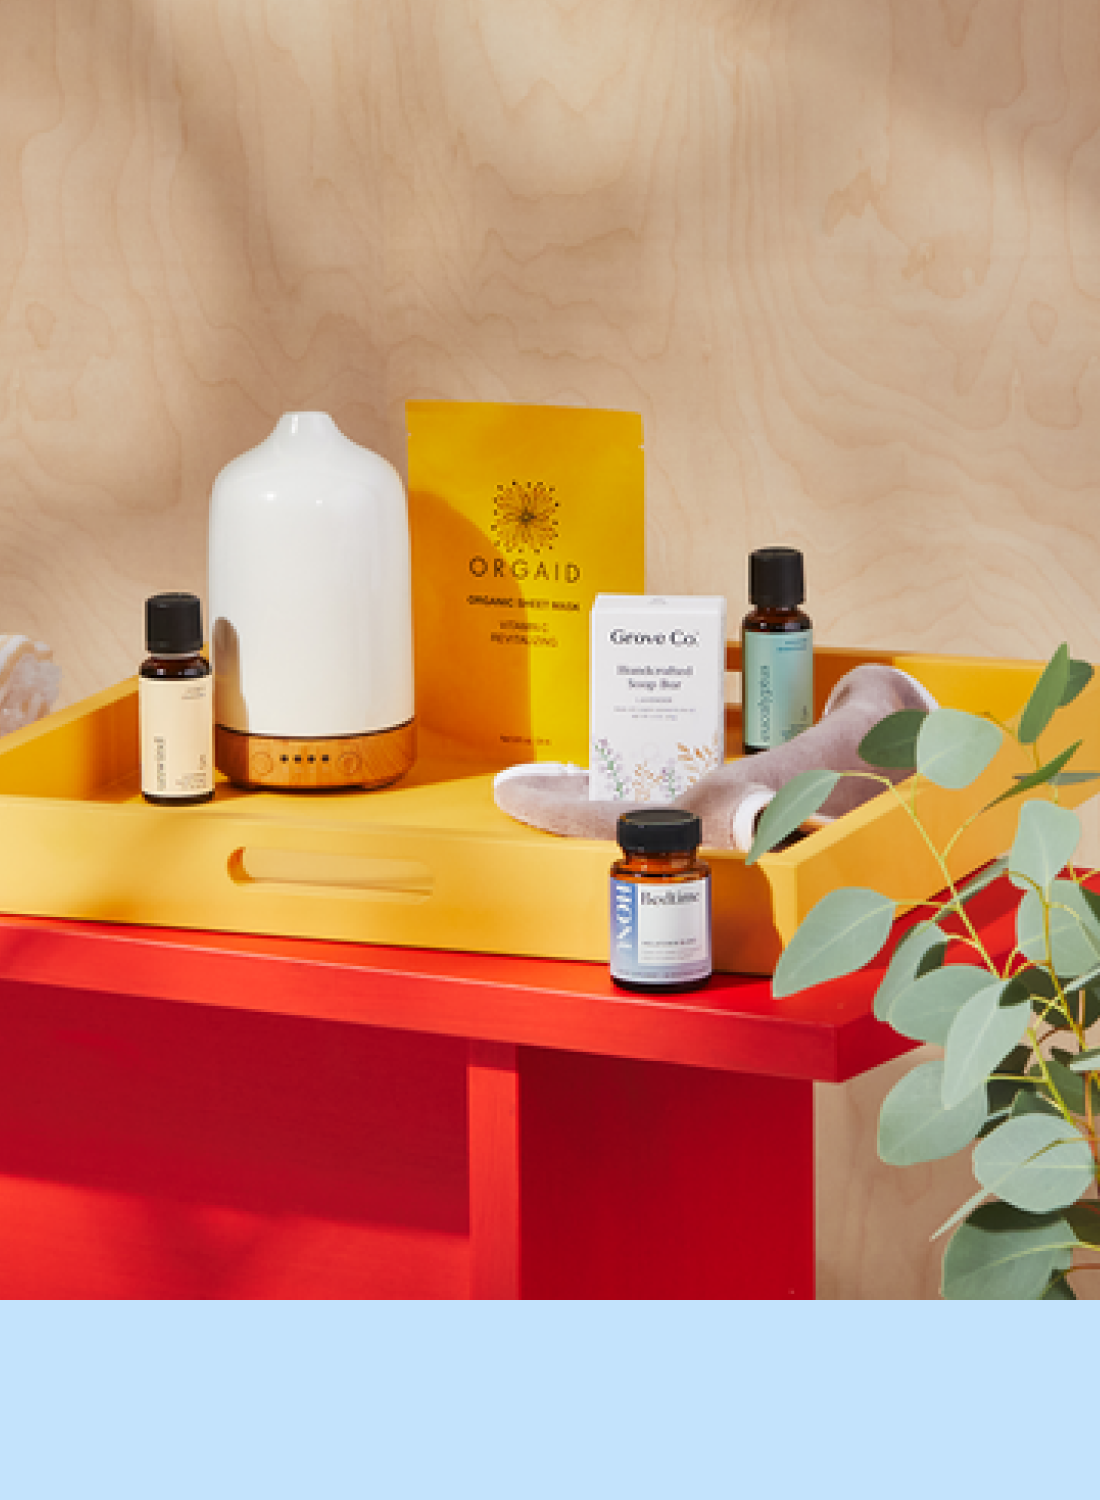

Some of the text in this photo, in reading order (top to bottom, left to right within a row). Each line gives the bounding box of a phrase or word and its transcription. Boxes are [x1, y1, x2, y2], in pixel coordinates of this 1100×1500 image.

[469, 556, 580, 583] ORGAID
[466, 595, 513, 608] ORGANIC
[518, 598, 549, 610] SHEET
[609, 628, 666, 645] Grove
